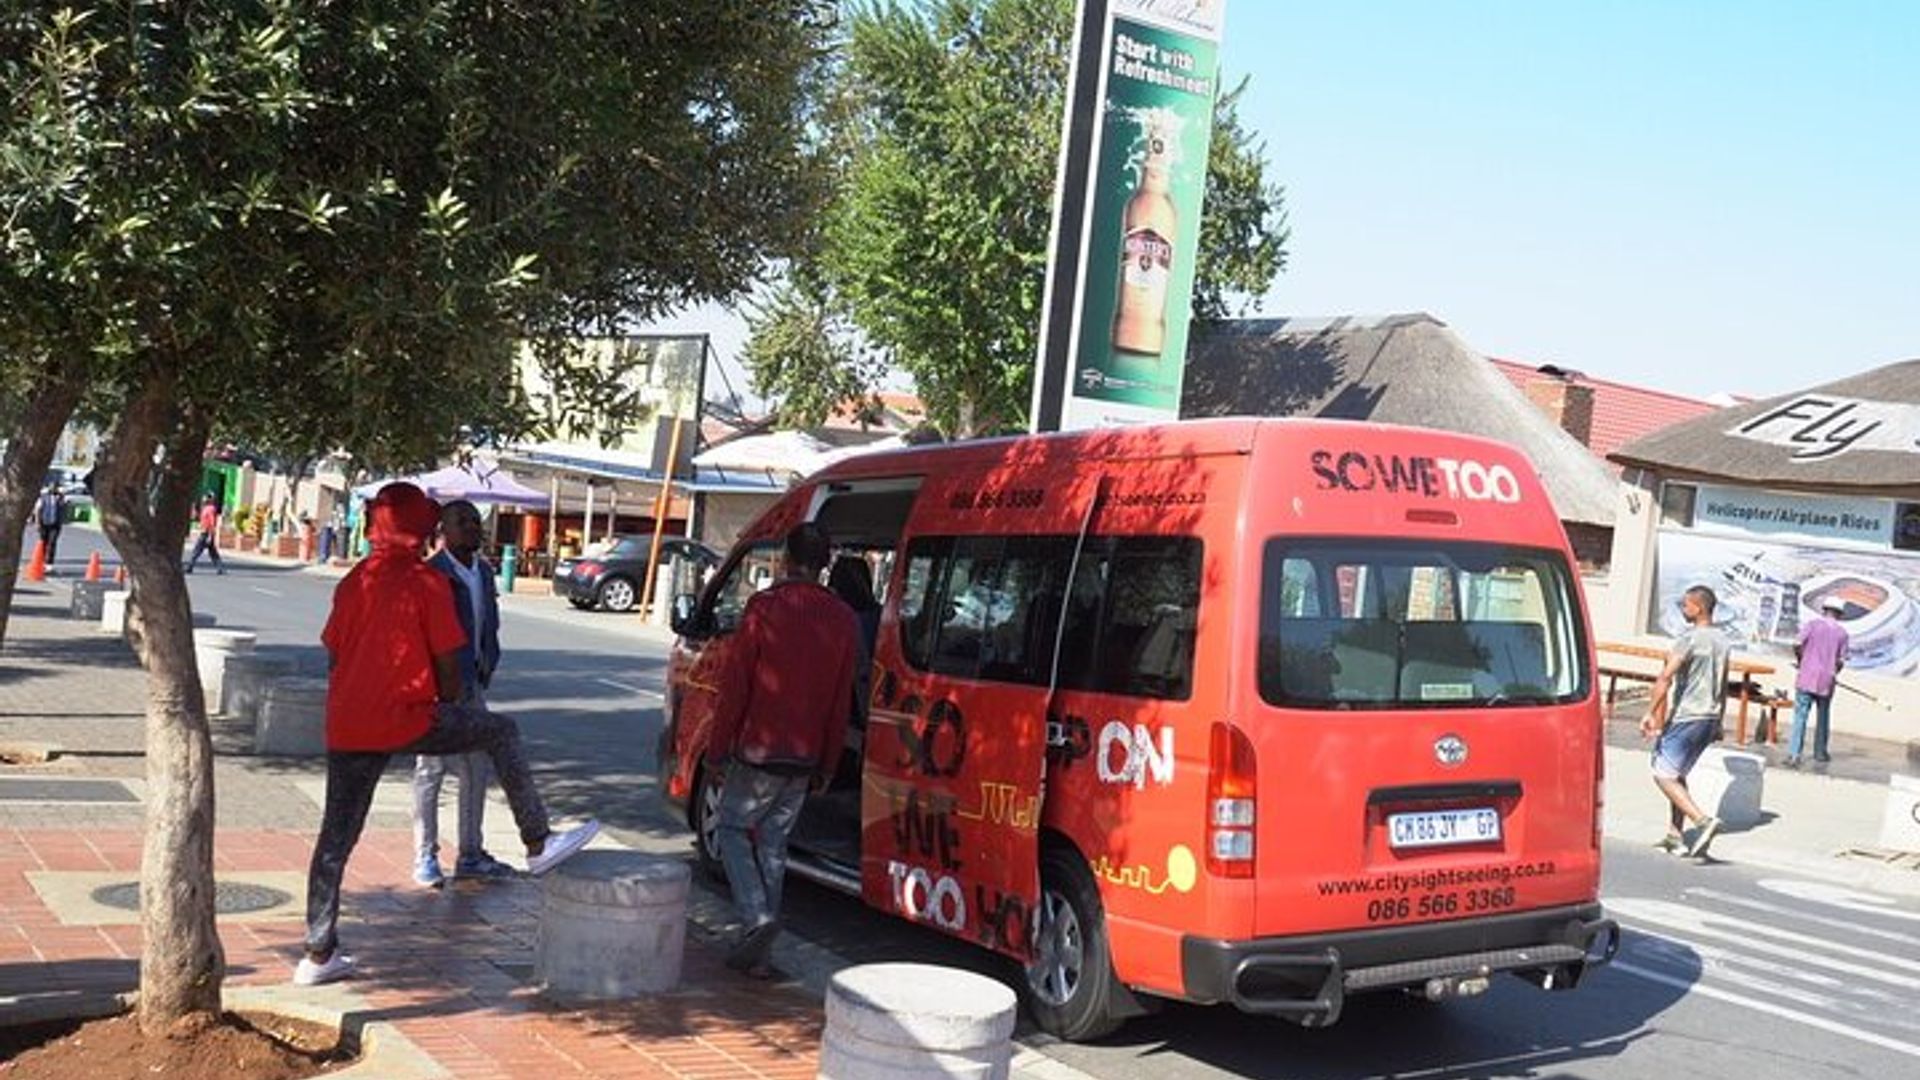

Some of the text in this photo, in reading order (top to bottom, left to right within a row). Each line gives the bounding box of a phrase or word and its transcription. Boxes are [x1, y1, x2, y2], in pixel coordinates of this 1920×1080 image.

[1114, 34, 1194, 71] Start with
[1741, 398, 1882, 459] Fly
[1707, 502, 1880, 531] Helicopter/Airplane Rides
[1097, 720, 1174, 790] ON
[1477, 810, 1494, 835] GP
[887, 861, 966, 930] TOO
[1318, 861, 1556, 896] www.citysightseeing.co.za
[1367, 887, 1517, 922] 086 566 3368
